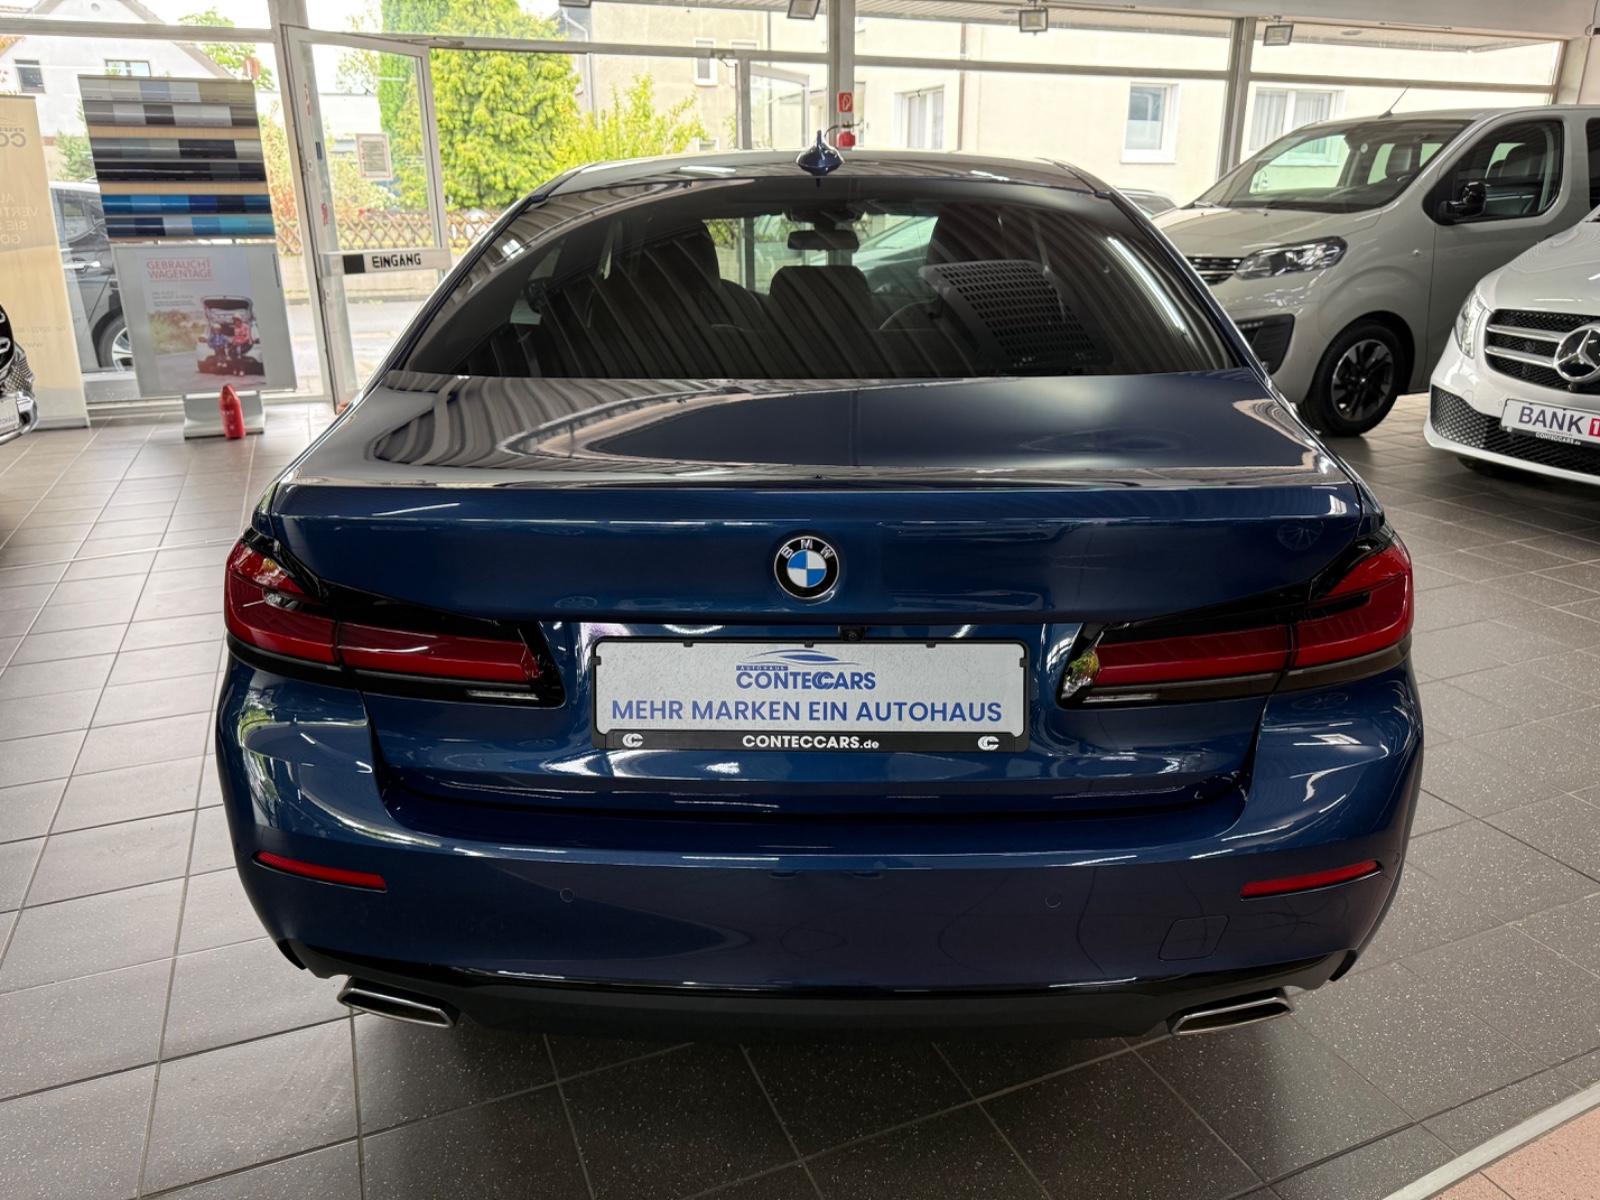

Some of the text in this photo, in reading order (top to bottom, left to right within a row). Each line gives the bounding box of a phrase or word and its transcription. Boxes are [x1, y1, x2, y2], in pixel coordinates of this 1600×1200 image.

[372, 253, 422, 268] EINGANG
[1518, 406, 1585, 434] BANK
[780, 539, 835, 560] BMW
[736, 671, 877, 690] CONTECCARS
[612, 700, 1002, 722] MEHR MARKEN EIN AUTOHAUS
[742, 735, 880, 749] CONTECCARS.de
